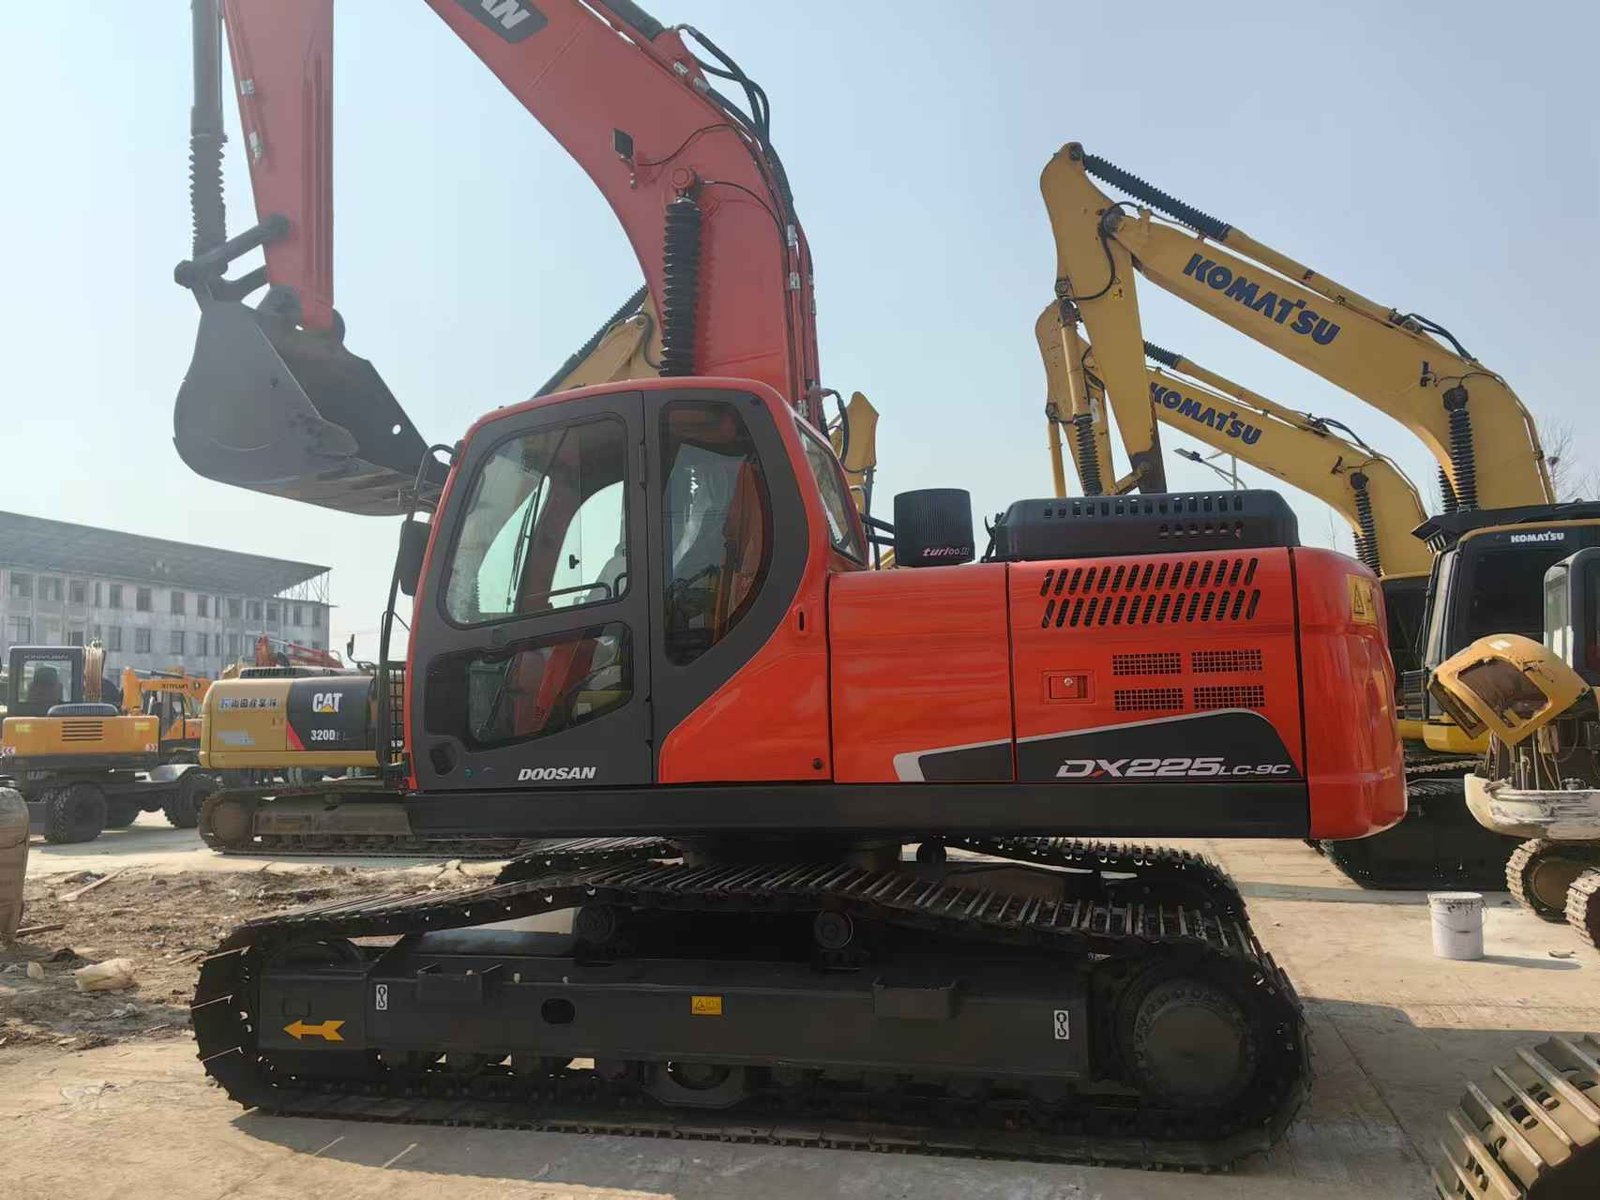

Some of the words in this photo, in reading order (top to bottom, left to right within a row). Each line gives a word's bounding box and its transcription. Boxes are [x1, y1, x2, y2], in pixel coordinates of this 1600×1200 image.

[1182, 252, 1342, 346] KOMATSU
[1510, 530, 1565, 543] KOMATSU
[312, 692, 344, 713] CAT
[310, 729, 336, 741] 320D
[517, 766, 597, 781] DOOSAN
